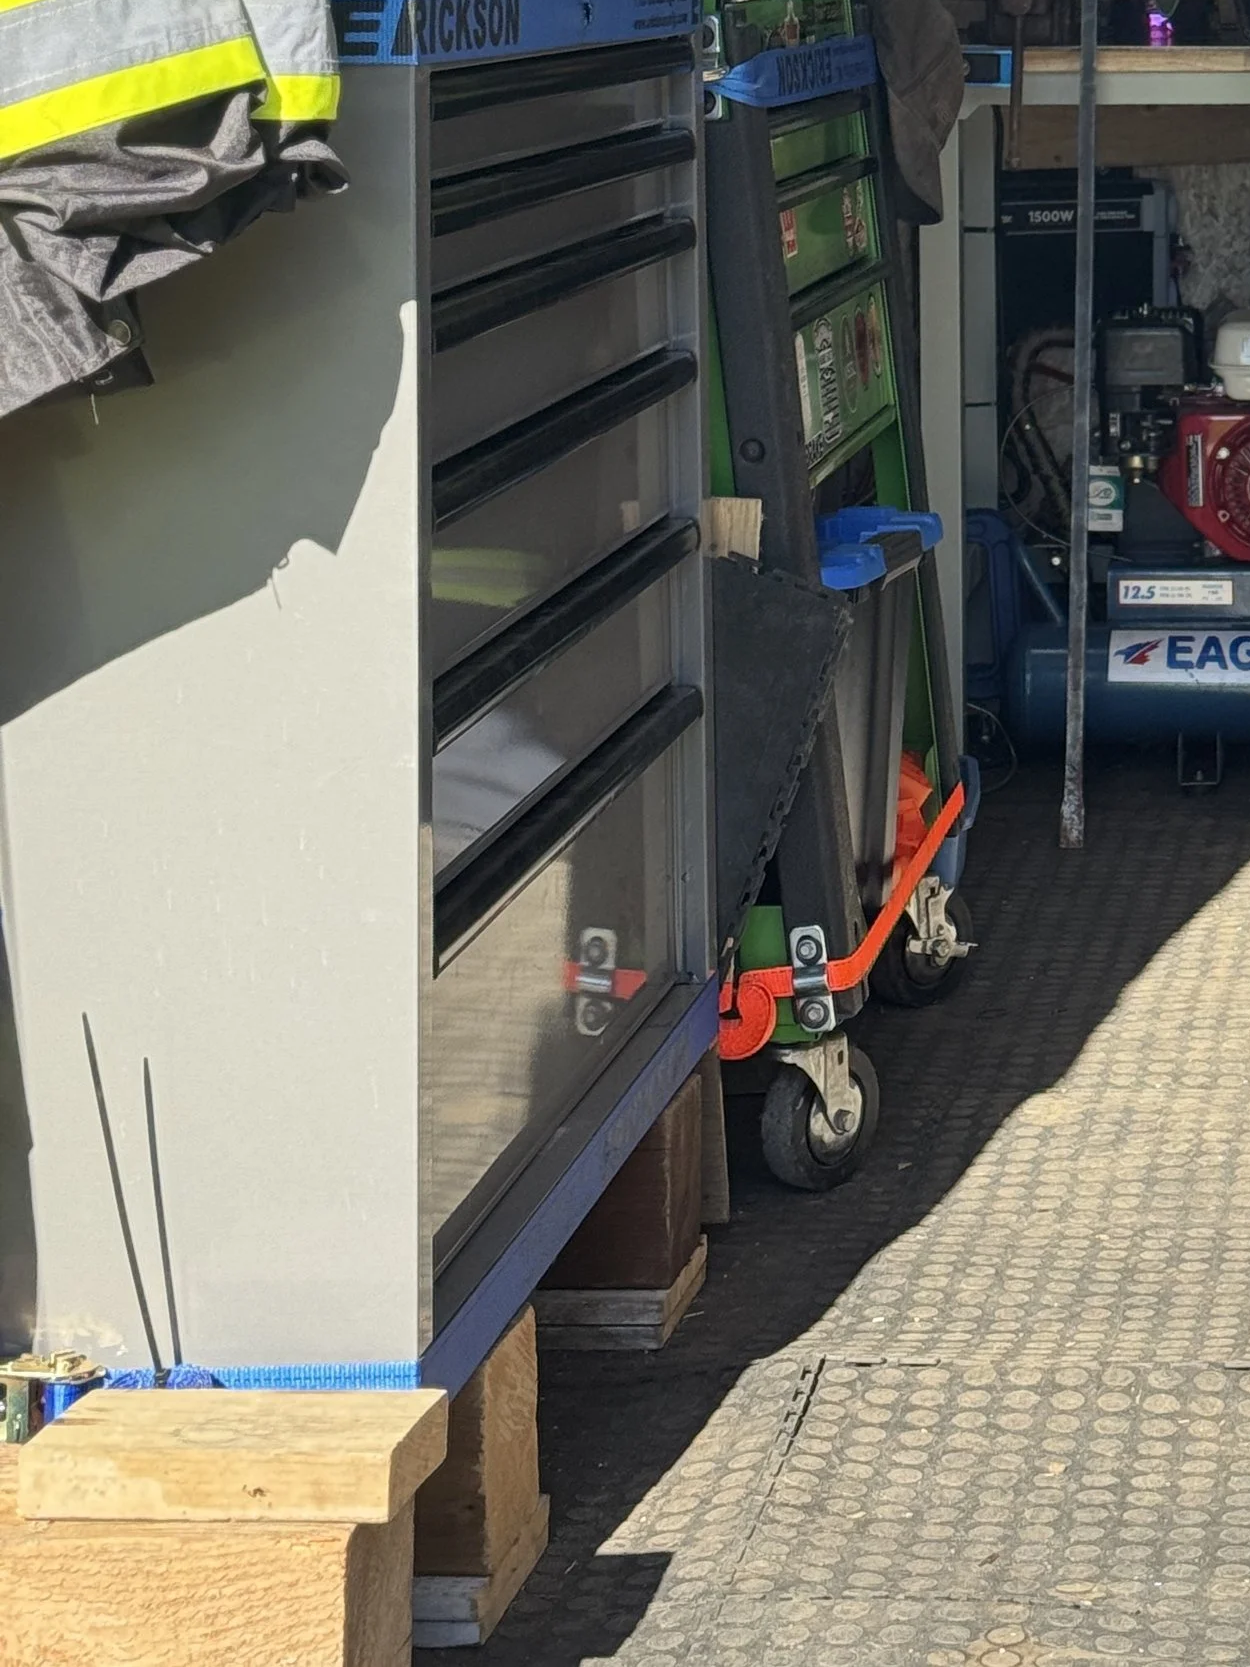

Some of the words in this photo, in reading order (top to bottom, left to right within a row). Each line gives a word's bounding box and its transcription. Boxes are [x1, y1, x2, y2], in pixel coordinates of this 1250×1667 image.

[776, 47, 832, 96] ERICKSON
[1027, 210, 1074, 223] 1500W
[1122, 585, 1156, 600] 12.5
